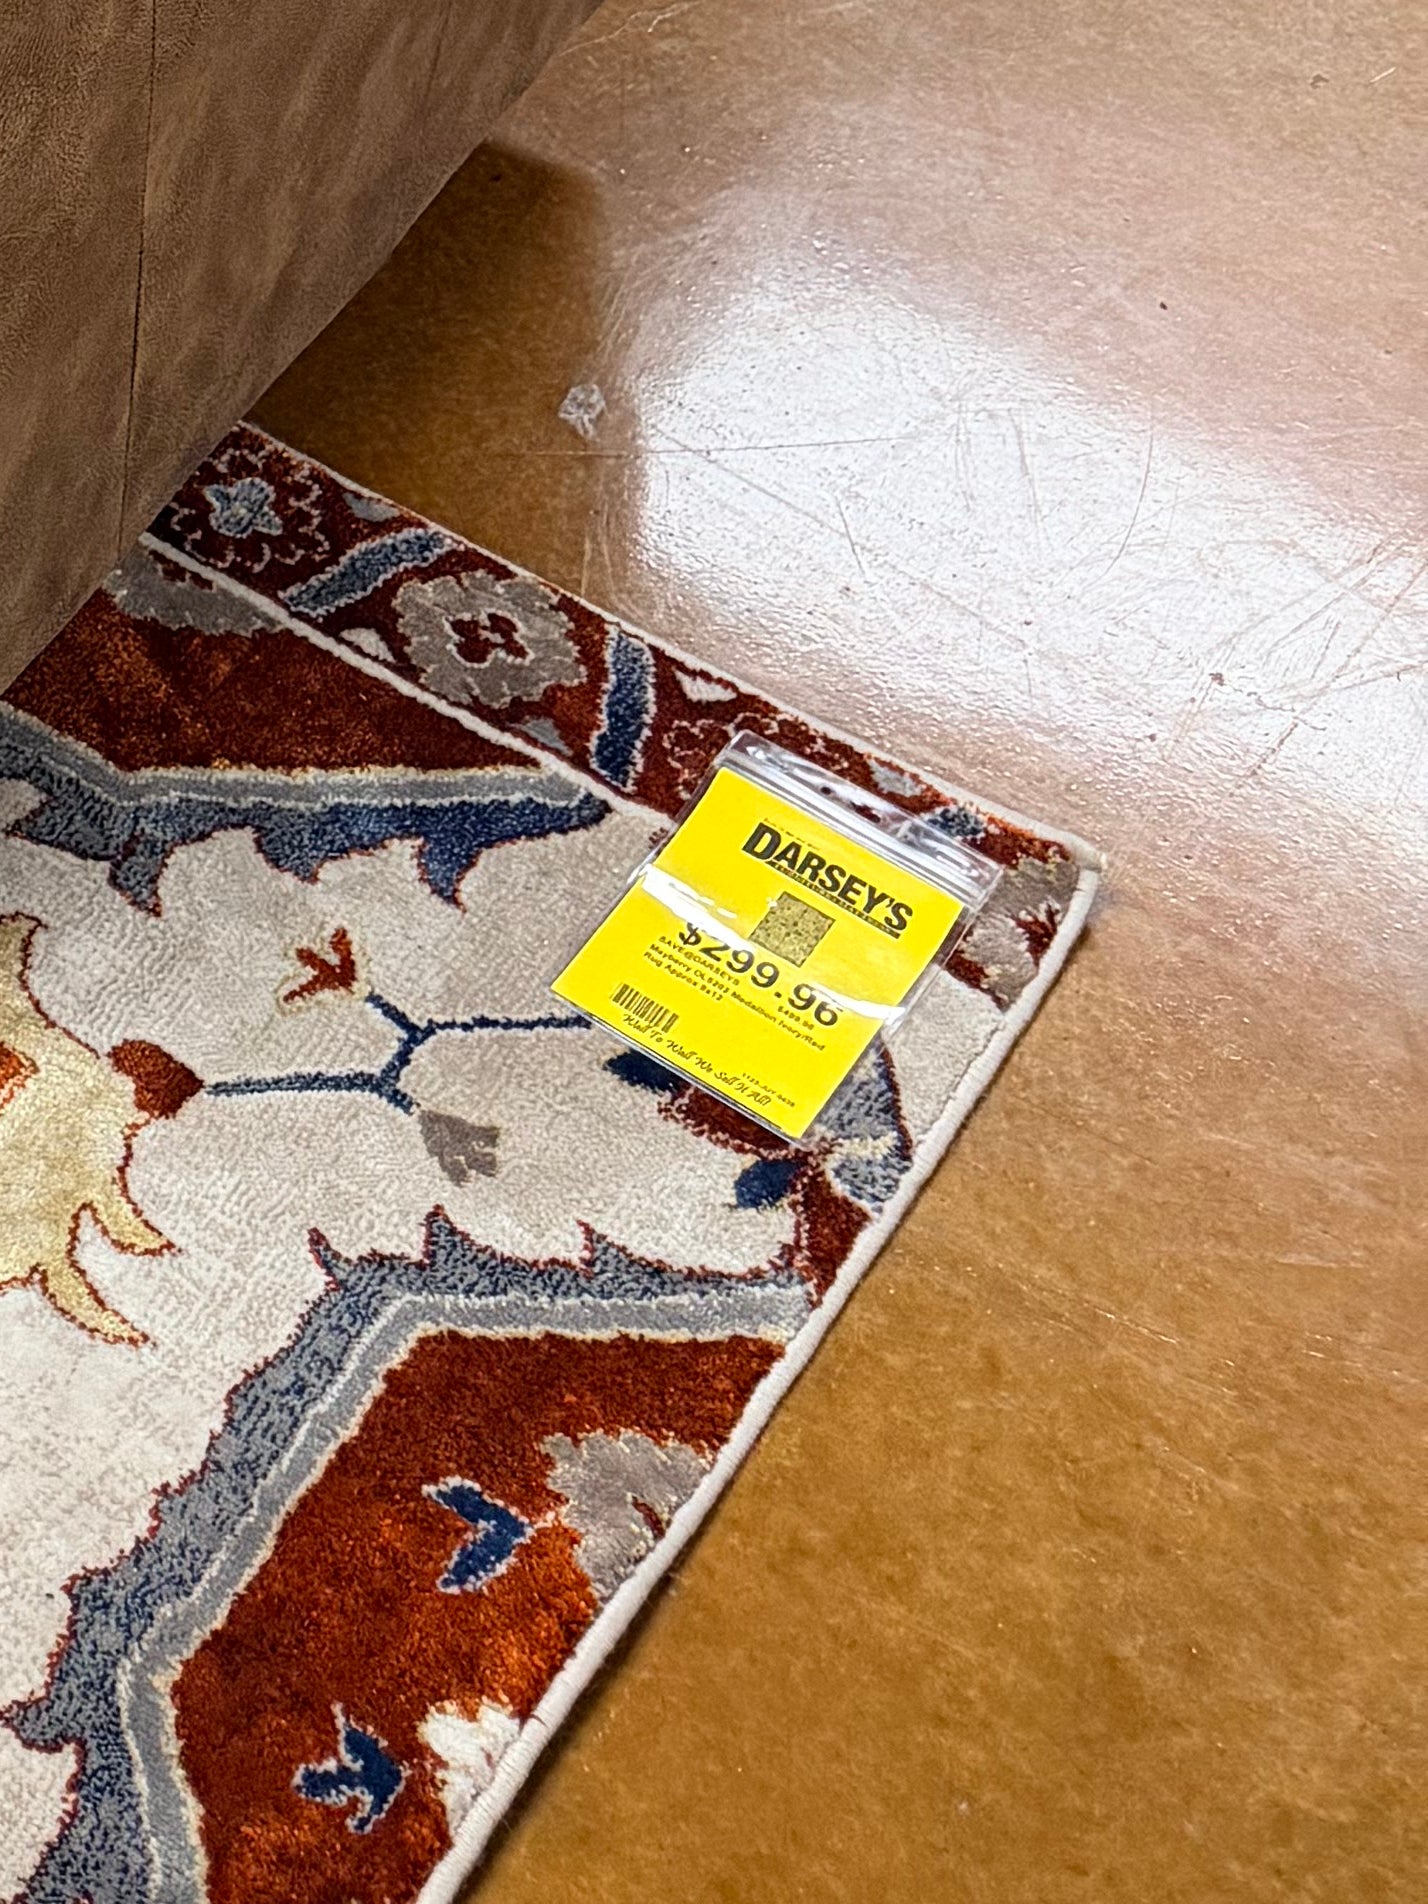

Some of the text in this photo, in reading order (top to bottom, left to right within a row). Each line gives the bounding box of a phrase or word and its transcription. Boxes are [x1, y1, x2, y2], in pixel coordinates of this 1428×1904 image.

[742, 822, 913, 939] DARSEY'S
[644, 952, 663, 967] Rug
[679, 922, 843, 1026] $299.96
[623, 1014, 651, 1033] Wall
[667, 1040, 697, 1060] Wall
[695, 1057, 713, 1072] We
[714, 1072, 741, 1085] Sell
